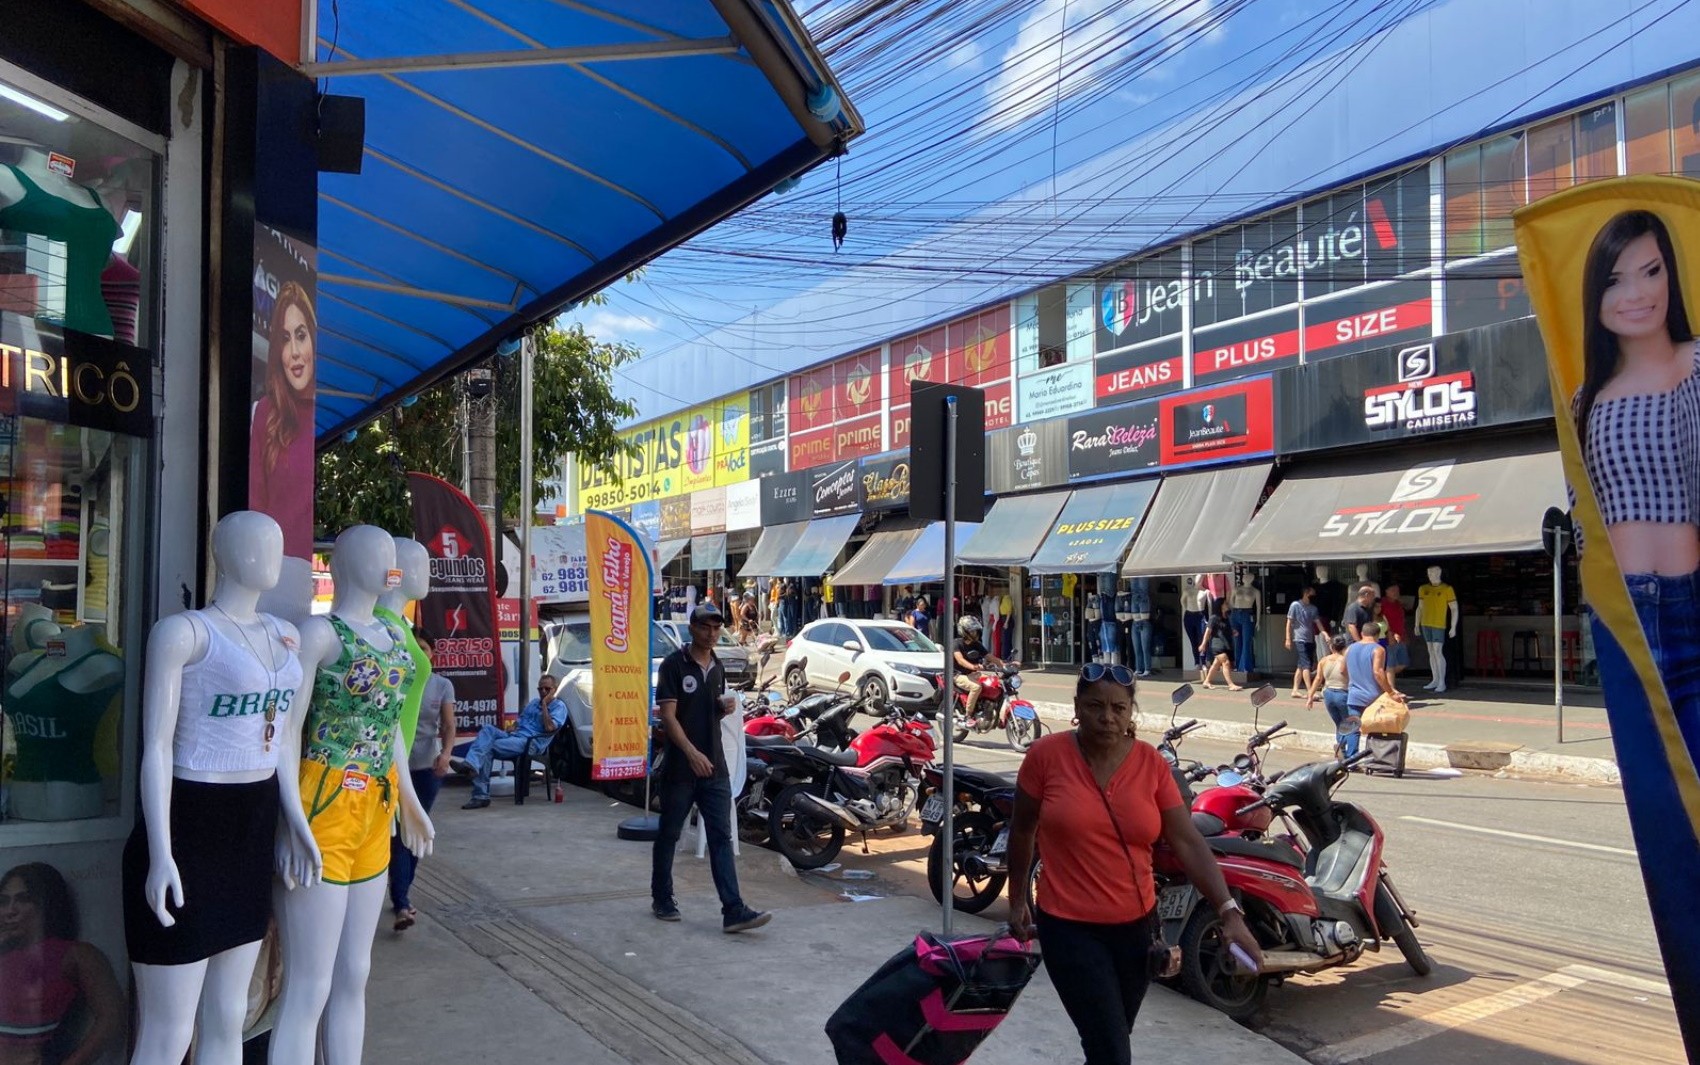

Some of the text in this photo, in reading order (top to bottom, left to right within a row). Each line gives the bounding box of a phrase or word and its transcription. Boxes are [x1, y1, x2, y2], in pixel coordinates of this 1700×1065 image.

[1139, 270, 1214, 324] Jean
[1235, 211, 1363, 290] Beauté
[1107, 309, 1398, 392] JEANS PLUS SIZE
[0, 343, 139, 412] TRICÔ
[1365, 381, 1476, 426] STYLOS
[1407, 411, 1475, 429] CAMISETAS
[792, 438, 830, 466] prime
[838, 425, 880, 455] prime
[587, 480, 661, 508] 99850-5014
[1057, 517, 1134, 534] PLUS SIZE
[1319, 506, 1465, 537] STYLOS
[442, 533, 458, 558] 5
[429, 555, 485, 579] egundos
[436, 638, 494, 653] ORRISO
[615, 691, 639, 700] CAMA
[615, 717, 638, 725] MESA
[613, 743, 641, 752] BANHO
